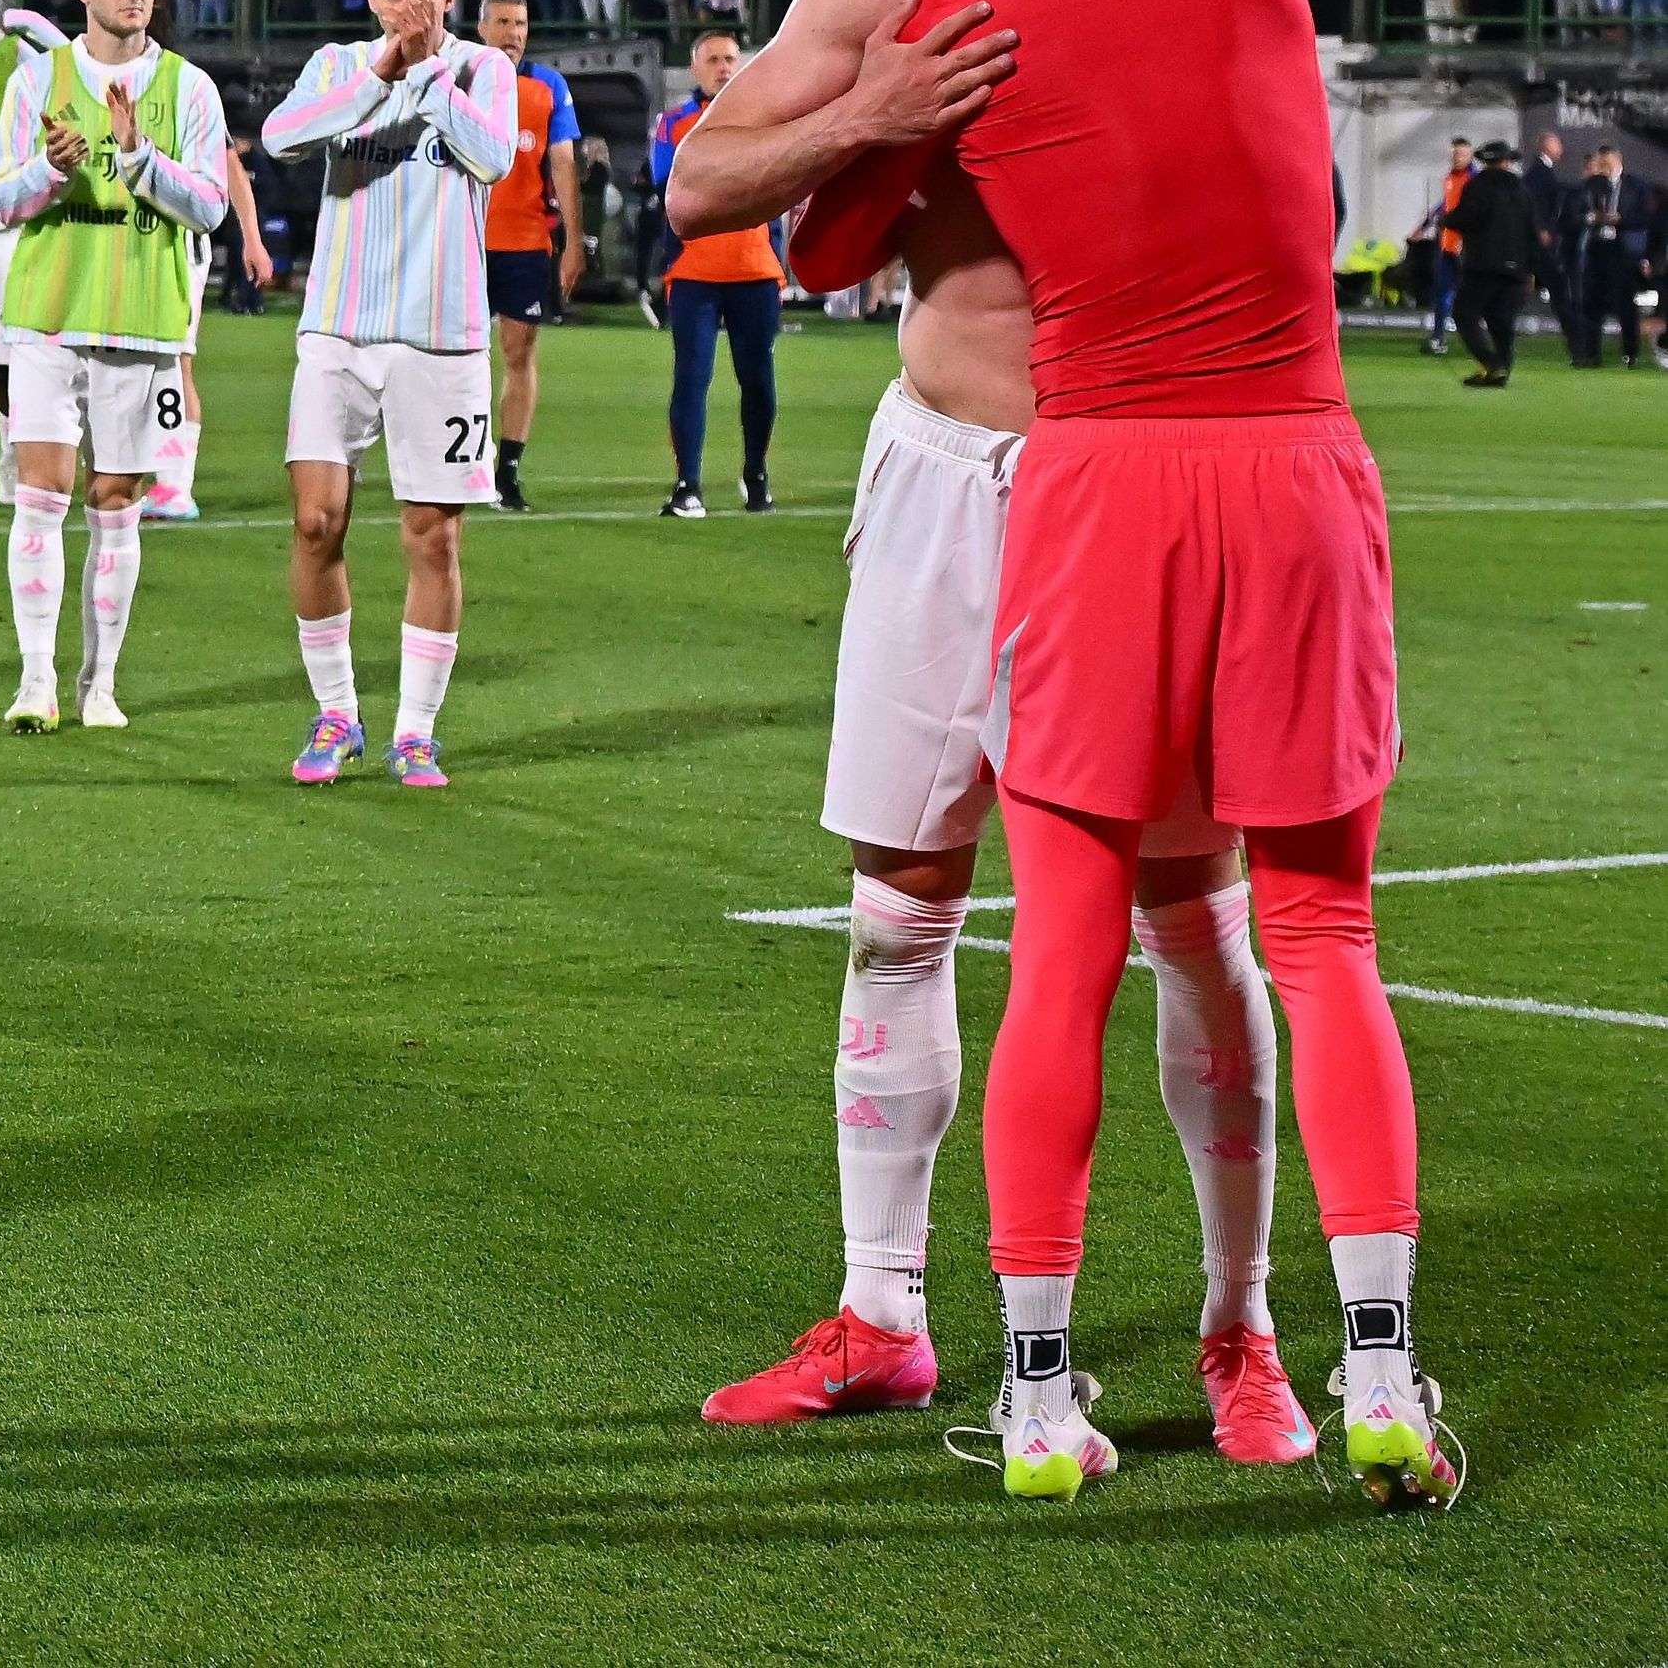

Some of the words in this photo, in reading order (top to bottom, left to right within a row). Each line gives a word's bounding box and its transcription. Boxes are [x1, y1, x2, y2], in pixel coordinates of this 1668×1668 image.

[343, 137, 418, 163] Allianz
[156, 387, 183, 430] 8
[444, 413, 489, 464] 27
[999, 1305, 1015, 1419] TAPEDESIGN
